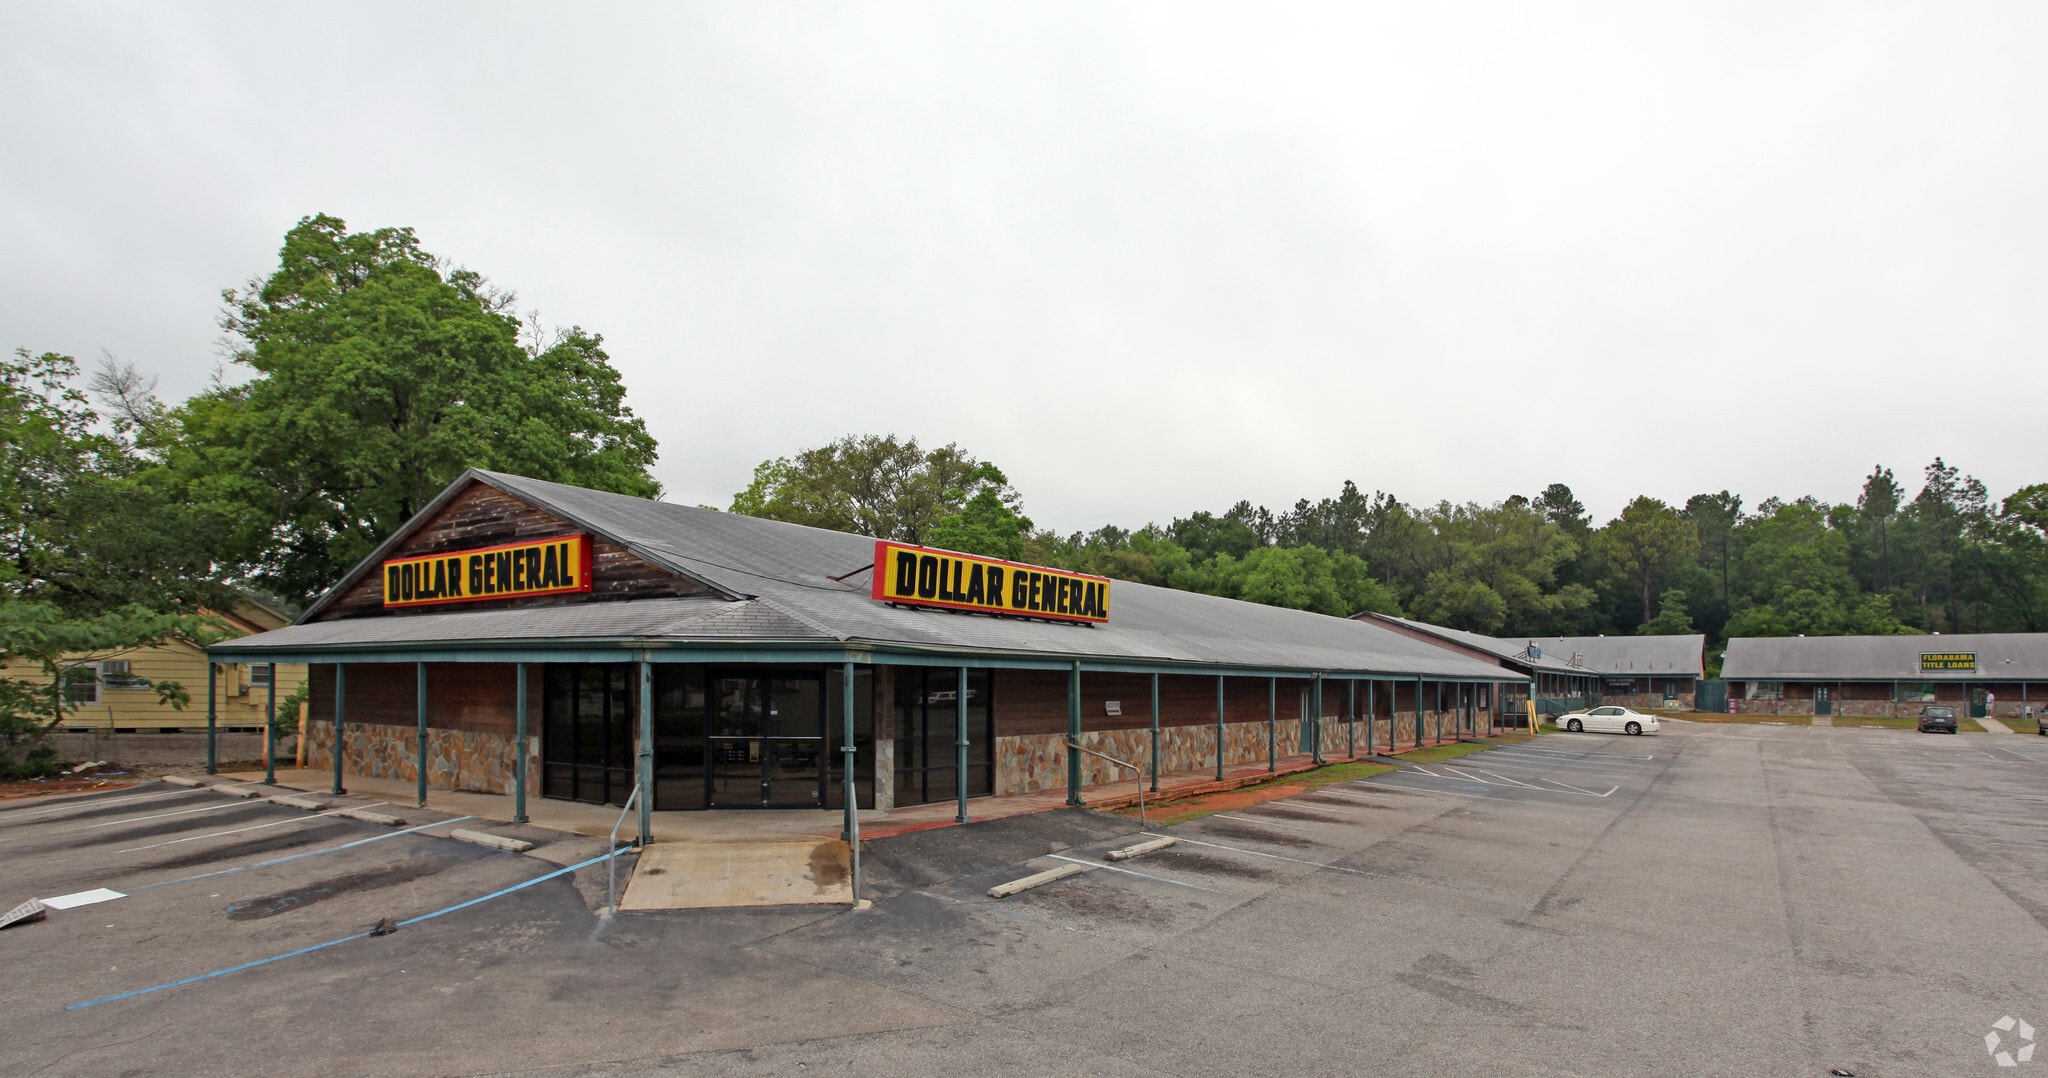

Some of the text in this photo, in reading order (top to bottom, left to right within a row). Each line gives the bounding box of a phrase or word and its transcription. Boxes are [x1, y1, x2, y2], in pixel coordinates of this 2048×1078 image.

[388, 543, 573, 602] DOLLAR GENERAL
[896, 551, 1107, 618] DOLLAR GENERAL
